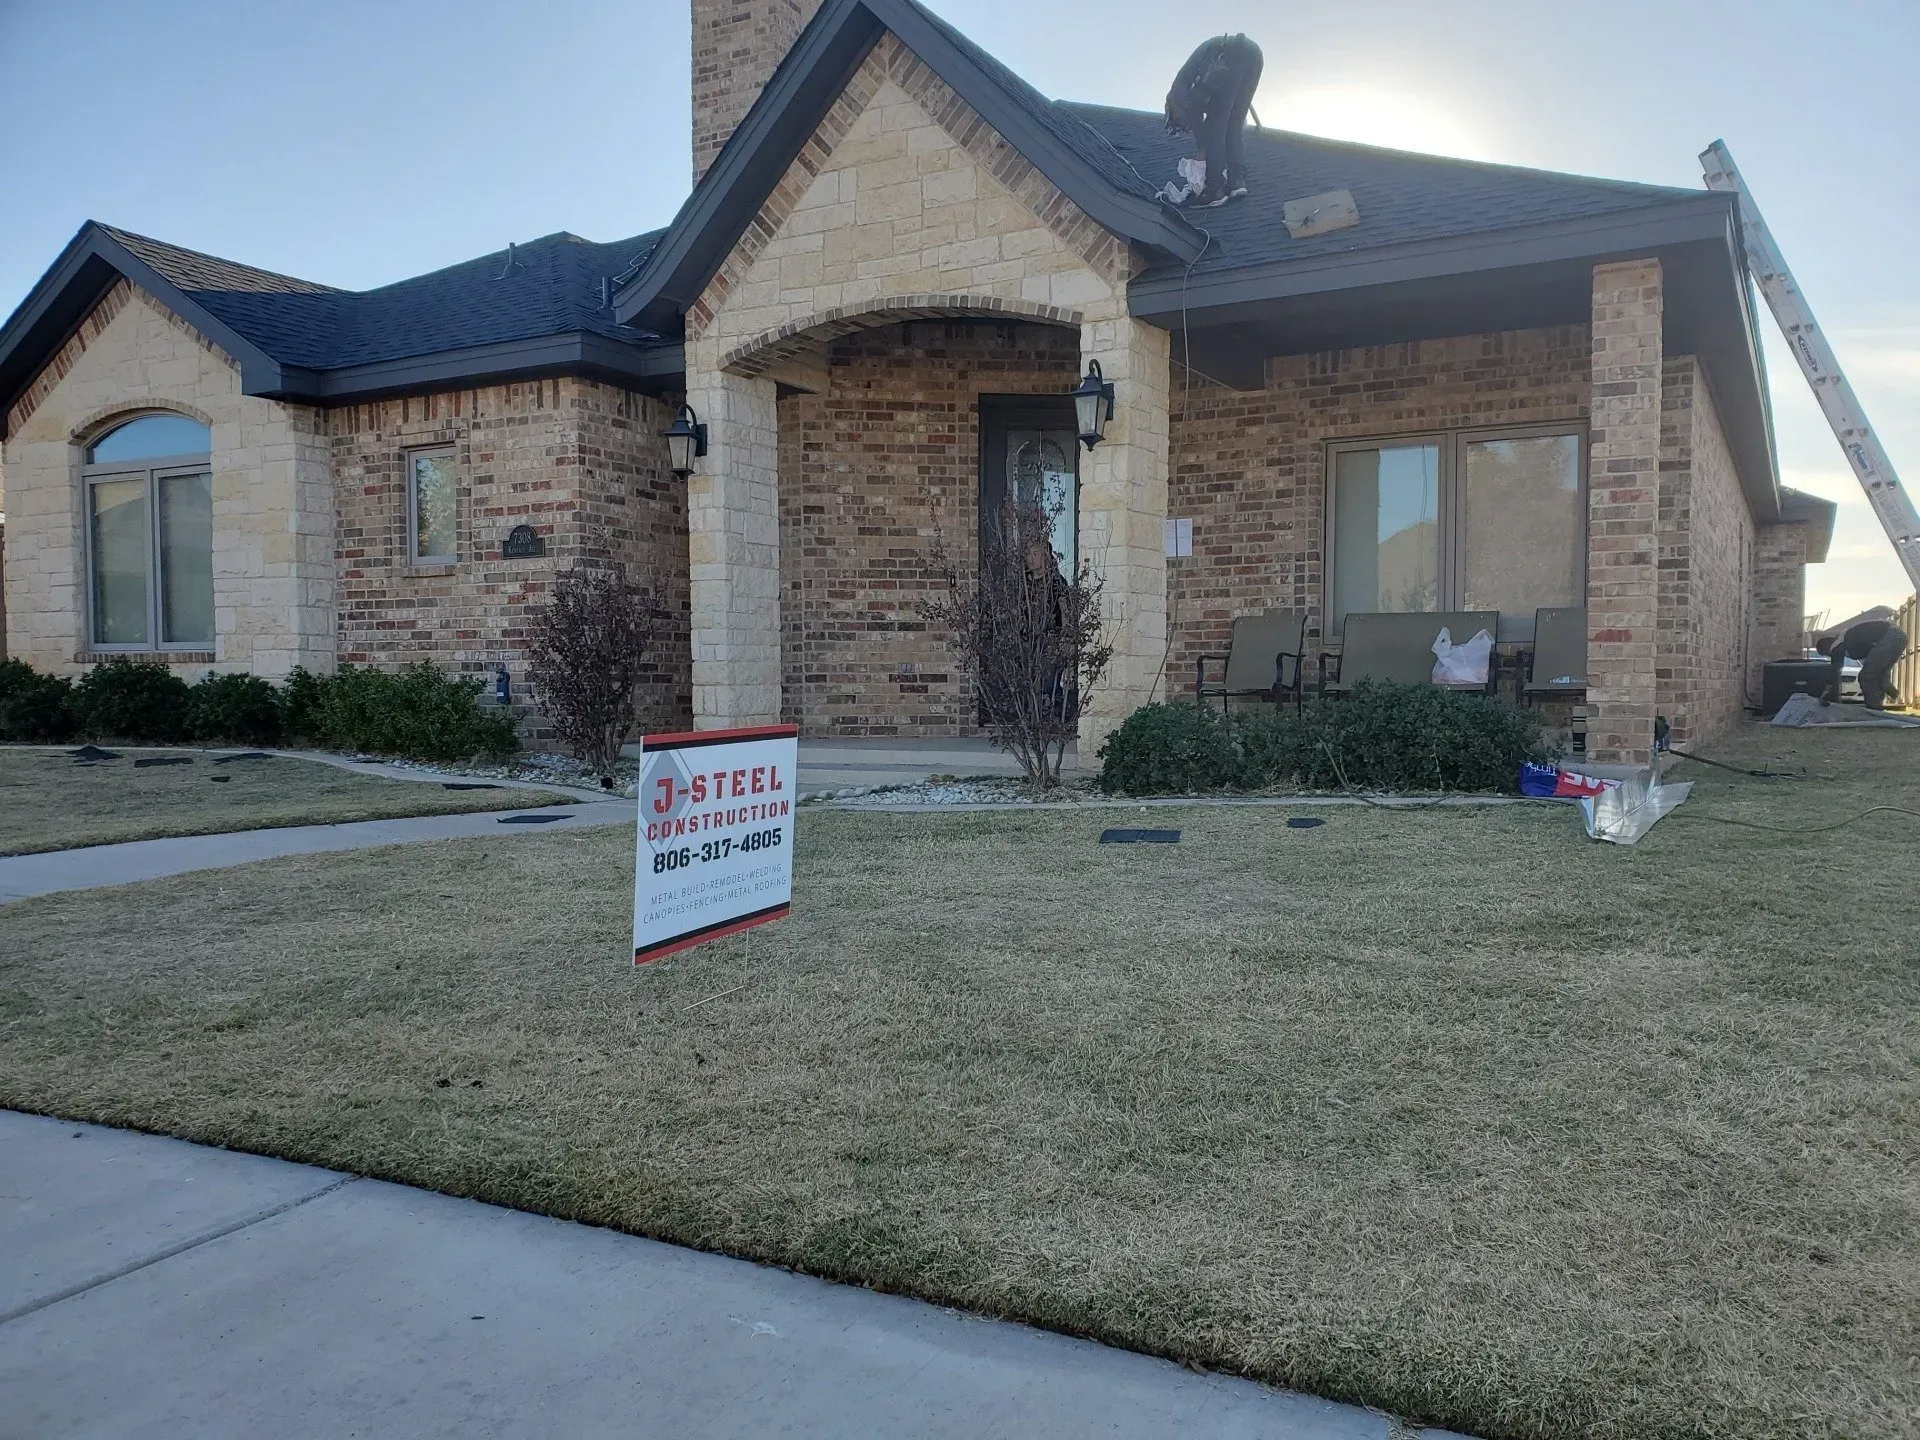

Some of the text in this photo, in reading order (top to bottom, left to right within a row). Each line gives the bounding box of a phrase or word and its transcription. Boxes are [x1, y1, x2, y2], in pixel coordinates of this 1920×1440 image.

[653, 765, 783, 814] J-STEEL
[647, 800, 789, 842] CONSTRUCTION
[653, 827, 782, 874] 806-317-4805
[651, 890, 677, 905] METAL
[754, 875, 787, 893] ROOFING
